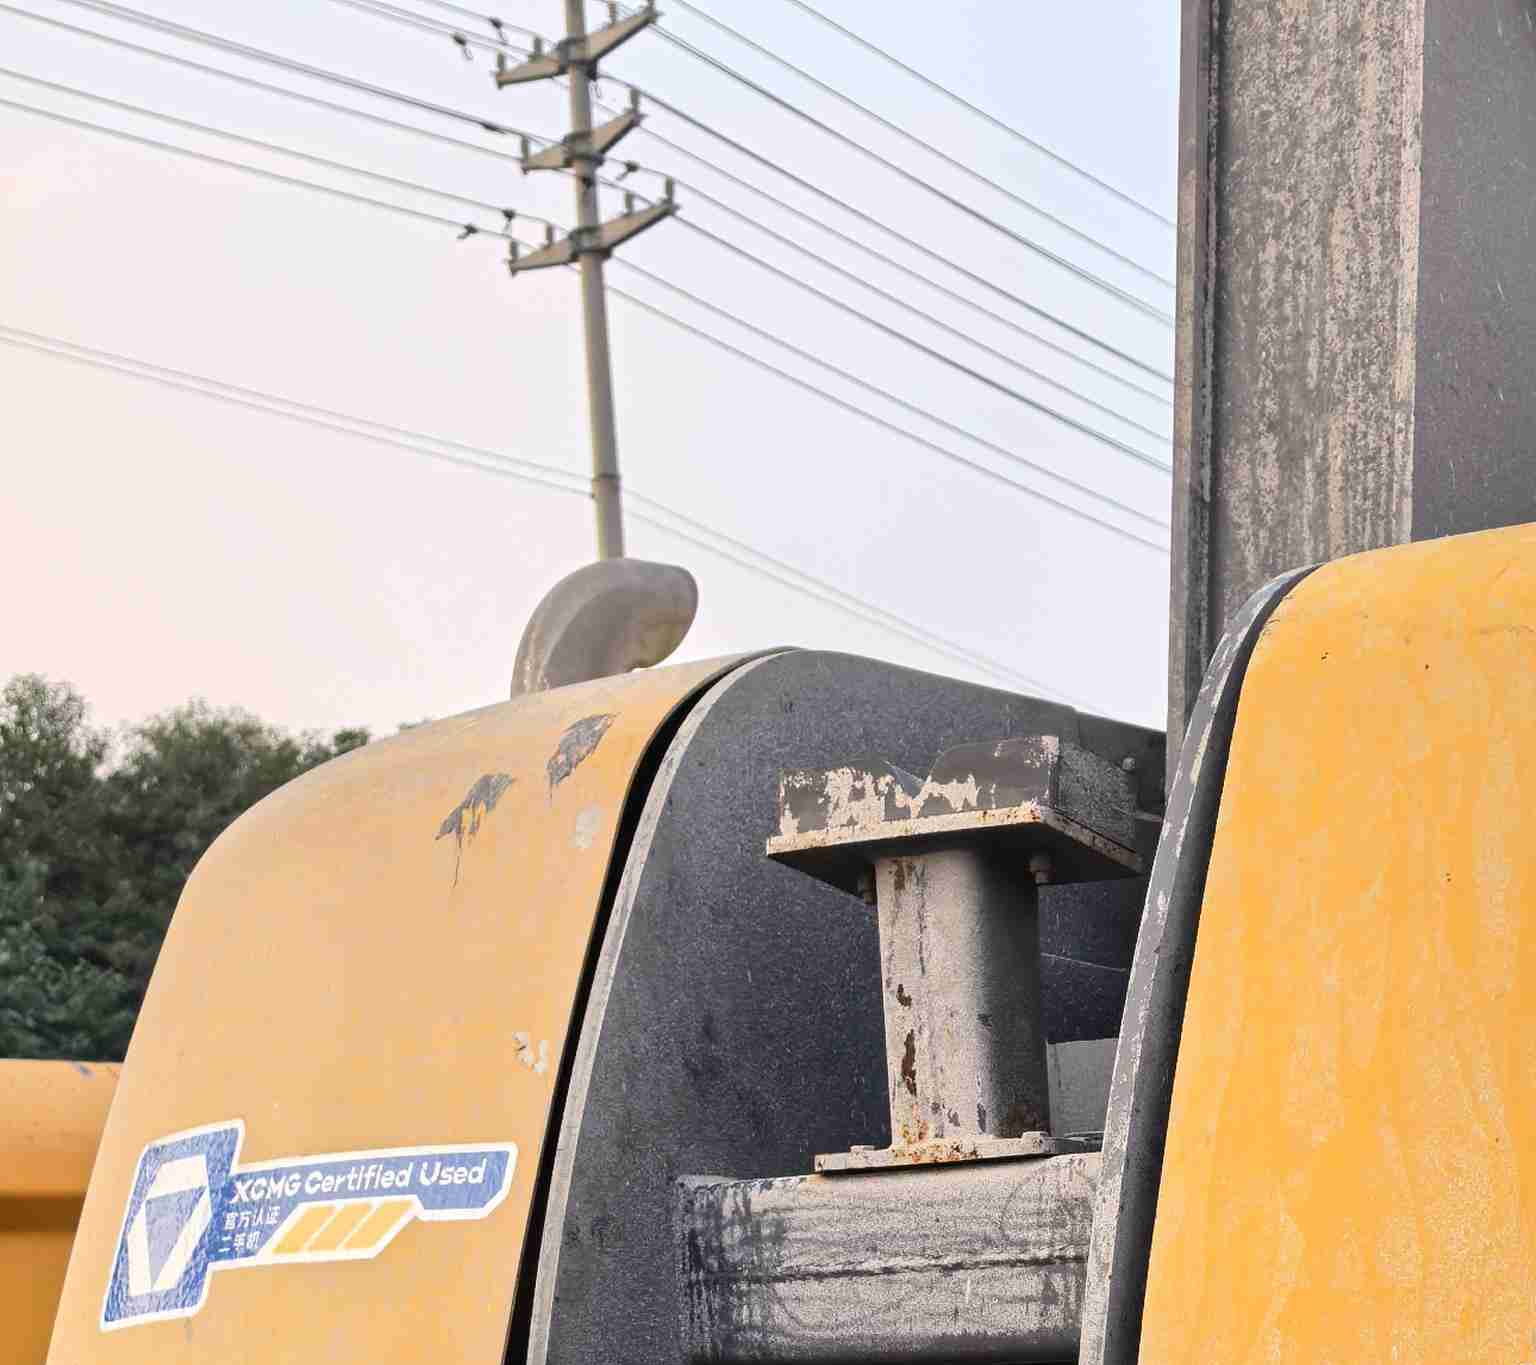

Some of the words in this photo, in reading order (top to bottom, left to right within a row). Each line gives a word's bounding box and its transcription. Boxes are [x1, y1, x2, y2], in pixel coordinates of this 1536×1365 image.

[232, 1174, 302, 1203] XCMG
[304, 1164, 412, 1193] Certified
[419, 1158, 487, 1186] Used
